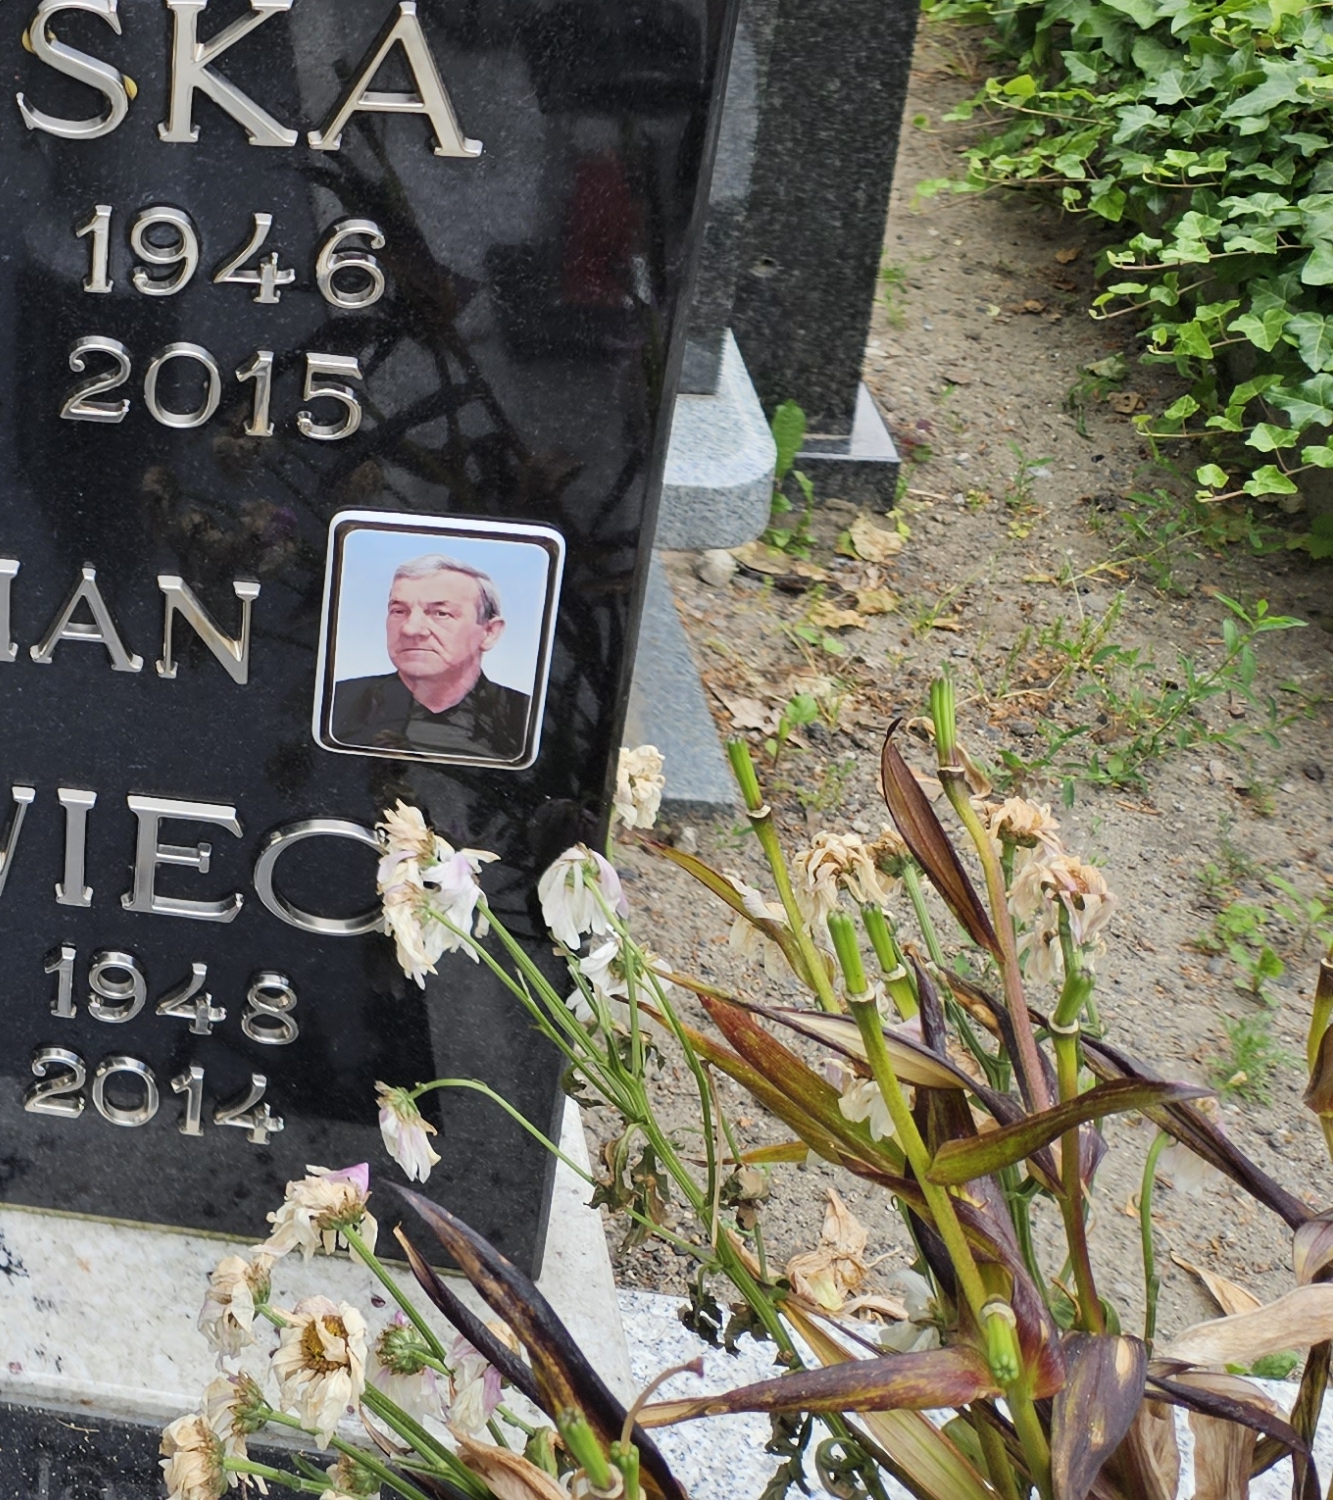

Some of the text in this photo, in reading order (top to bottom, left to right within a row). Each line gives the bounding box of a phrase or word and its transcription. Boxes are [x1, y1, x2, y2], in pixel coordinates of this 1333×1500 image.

[76, 204, 386, 309] 1946
[59, 334, 363, 439] 2015
[44, 942, 298, 1045] 1948
[25, 1046, 284, 1145] 2014
